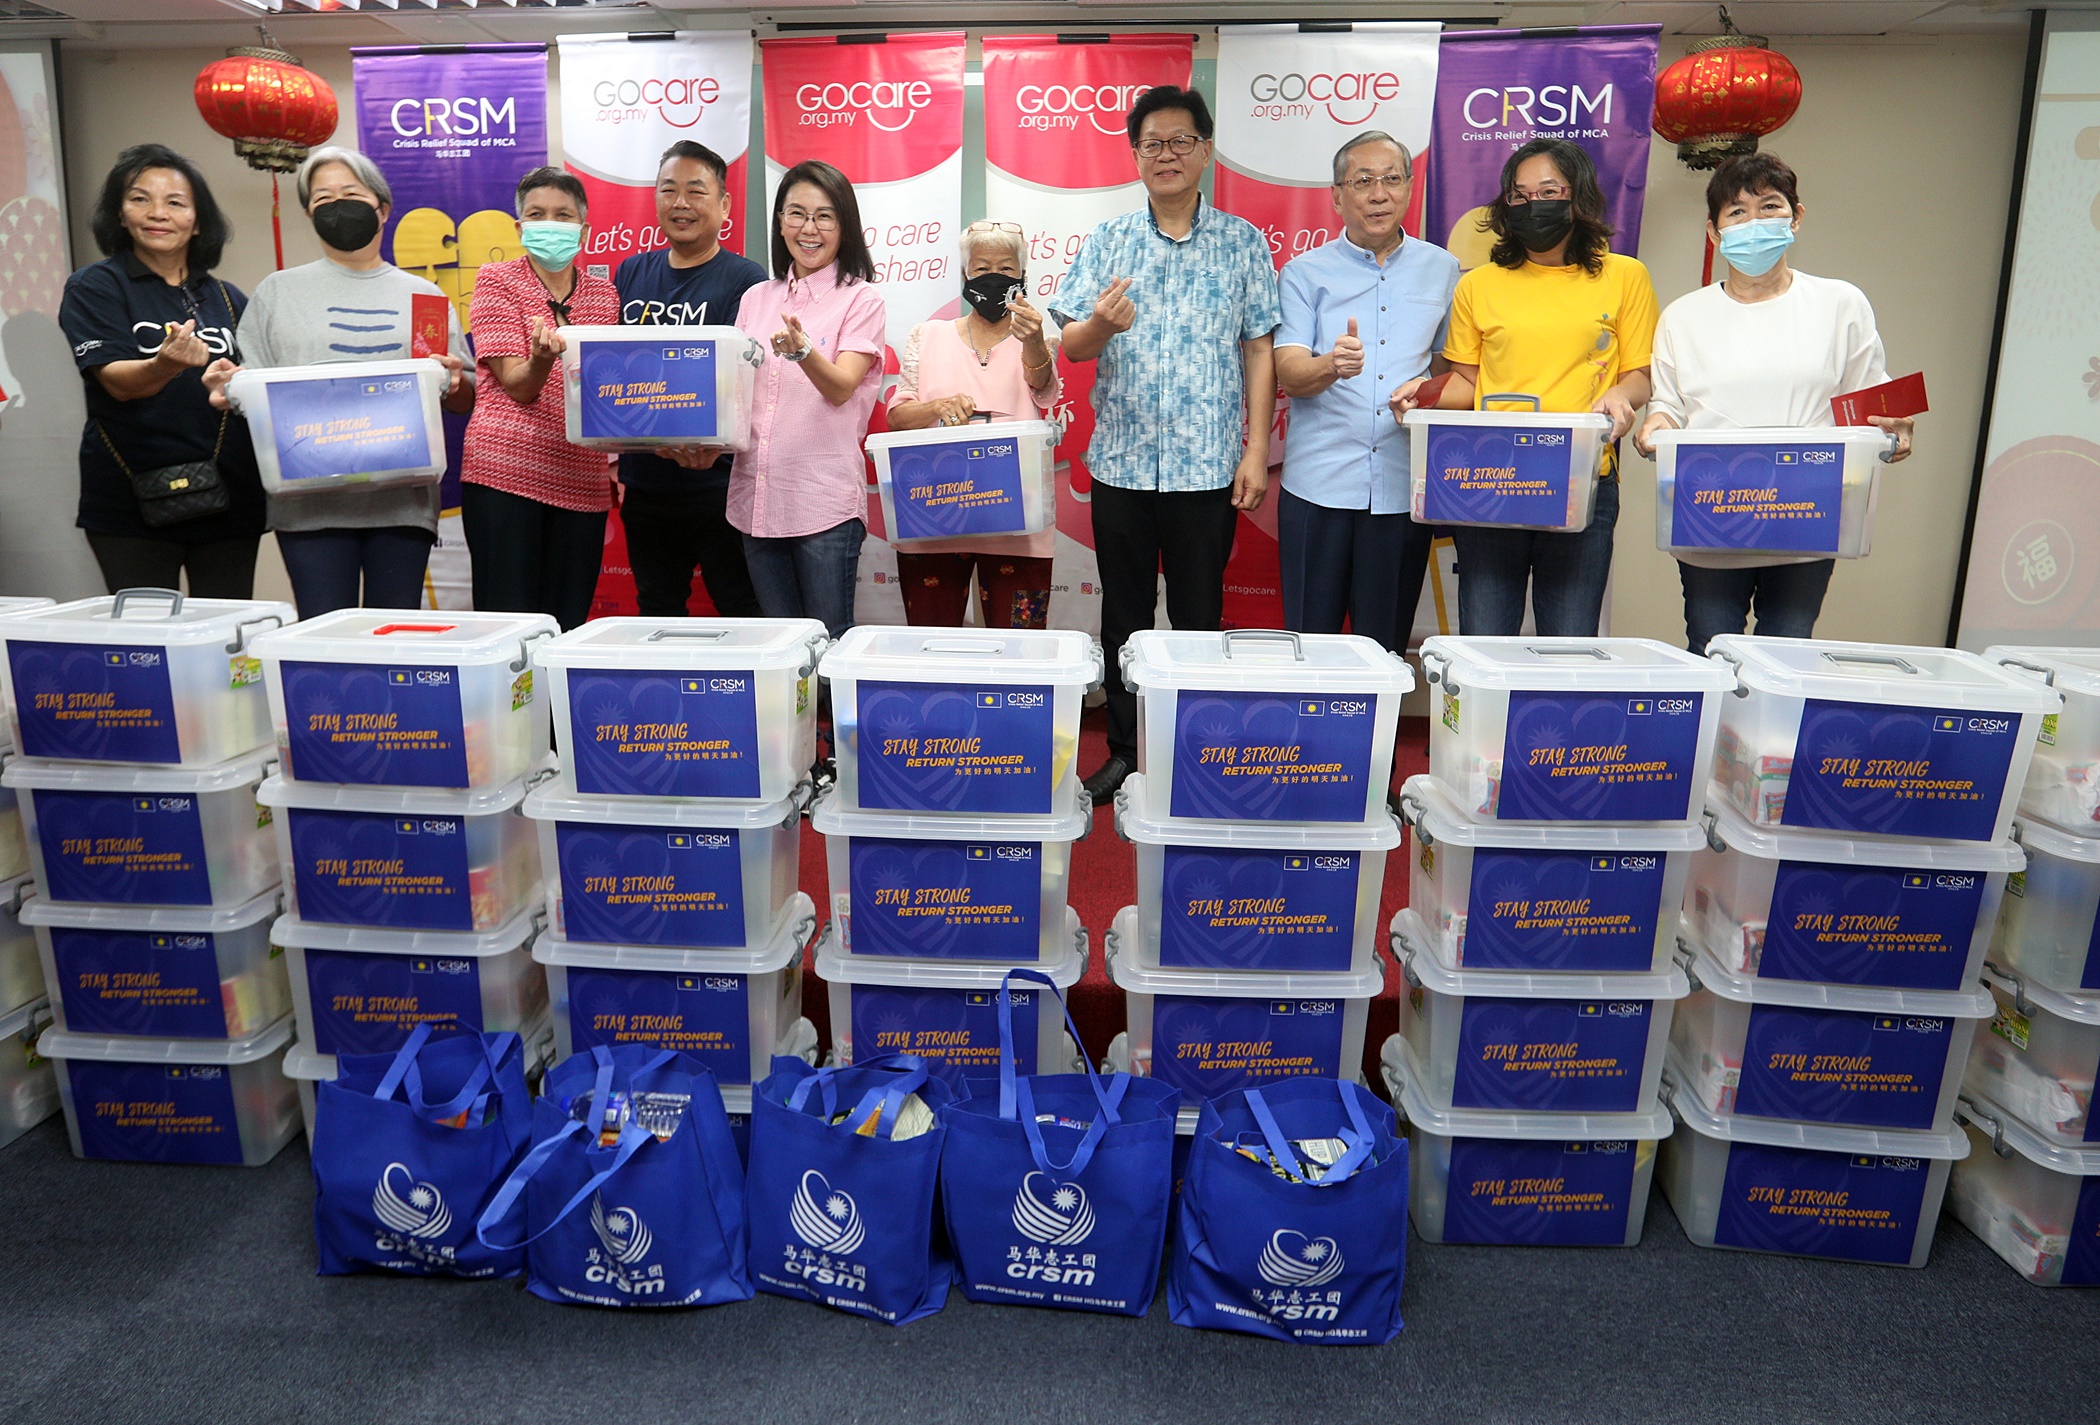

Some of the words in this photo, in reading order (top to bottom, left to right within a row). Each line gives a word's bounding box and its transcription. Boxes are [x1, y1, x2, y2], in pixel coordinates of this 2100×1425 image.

[1250, 103, 1314, 122] .org.my
[1463, 84, 1613, 129] CRSM
[391, 97, 516, 136] CRSM
[595, 108, 648, 125] .org.my
[798, 111, 857, 128] .org.my
[1018, 112, 1079, 131] .org.my
[392, 140, 419, 148] Crisis
[421, 138, 448, 147] Relief
[449, 138, 479, 148] Squad
[481, 138, 491, 146] of
[493, 138, 516, 147] MCA
[1462, 132, 1492, 141] Crisis
[1495, 130, 1527, 140] Relief
[1530, 130, 1564, 140] Squad
[1568, 130, 1579, 139] of
[1583, 129, 1609, 138] MCA
[584, 222, 634, 254] Let's
[886, 222, 942, 246] care
[872, 255, 948, 284] share!
[623, 299, 708, 326] CRSM
[683, 348, 708, 356] CRSM
[598, 384, 624, 398] STAY
[626, 381, 667, 396] STRONG
[614, 396, 650, 406] RETURN
[650, 393, 697, 403] STRONGER
[1537, 434, 1564, 443] CRSM
[987, 445, 1010, 455] CRSM
[1802, 452, 1834, 461] CRSM
[1443, 468, 1471, 482] STAY
[1473, 467, 1516, 480] STRONG
[909, 485, 933, 500] STAY
[936, 480, 974, 497] STRONG
[1460, 481, 1497, 490] RETURN
[1498, 480, 1547, 489] STRONGER
[926, 496, 959, 506] RETURN
[960, 489, 1003, 502] STRONGER
[1693, 490, 1725, 505] STAY
[1728, 488, 1778, 503] STRONG
[1712, 504, 1756, 514] RETURN
[1756, 502, 1815, 512] STRONGER
[2016, 534, 2058, 590] 福
[417, 670, 449, 681] CRSM
[710, 678, 744, 689] CRSM
[34, 693, 64, 710] STAY
[68, 692, 115, 709] STRONG
[1007, 693, 1042, 704] CRSM
[1330, 701, 1367, 712] CRSM
[1657, 699, 1692, 710] CRSM
[55, 710, 97, 720] RETURN
[98, 709, 152, 719] STRONGER
[309, 714, 341, 732] STAY
[346, 713, 398, 730] STRONG
[595, 724, 629, 742] STAY
[634, 722, 688, 741] STRONG
[1967, 718, 2007, 730] CRSM
[331, 732, 377, 743] RETURN
[378, 730, 438, 742] STRONGER
[618, 742, 666, 753] RETURN
[667, 740, 730, 752] STRONGER
[882, 739, 919, 757] STAY
[923, 737, 981, 755] STRONG
[906, 757, 956, 768] RETURN
[958, 755, 1024, 767] STRONGER
[1200, 747, 1238, 765] STAY
[1241, 745, 1301, 764] STRONG
[1529, 748, 1566, 766] STAY
[1569, 744, 1628, 764] STRONG
[1222, 765, 1274, 776] RETURN
[1275, 763, 1343, 775] STRONGER
[1550, 765, 1601, 777] RETURN
[1602, 761, 1668, 774] STRONGER
[1819, 758, 1862, 777] STAY
[1864, 759, 1931, 778] STRONG
[1842, 778, 1899, 788] RETURN
[1899, 779, 1974, 790] STRONGER
[695, 834, 729, 844] CRSM
[996, 845, 1031, 856] CRSM
[316, 859, 348, 876] STAY
[352, 859, 404, 875] STRONG
[1314, 855, 1350, 866] CRSM
[1620, 856, 1654, 867] CRSM
[337, 877, 383, 886] RETURN
[384, 876, 444, 886] STRONGER
[584, 877, 618, 894] STAY
[622, 875, 675, 892] STRONG
[1935, 874, 1973, 886] CRSM
[606, 894, 653, 904] RETURN
[655, 892, 716, 903] STRONGER
[875, 889, 910, 906] STAY
[914, 887, 971, 905] STRONG
[897, 906, 946, 917] RETURN
[948, 905, 1013, 916] STRONGER
[1187, 899, 1224, 917] STAY
[1228, 897, 1286, 915] STRONG
[1493, 901, 1530, 918] STAY
[1533, 898, 1591, 917] STRONG
[1209, 917, 1260, 927] RETURN
[1261, 914, 1328, 926] STRONGER
[1514, 918, 1565, 929] RETURN
[1566, 915, 1631, 927] STRONGER
[1794, 914, 1835, 932] STAY
[1837, 915, 1901, 931] STRONG
[1816, 933, 1870, 942] RETURN
[1871, 933, 1942, 943] STRONGER
[1905, 1017, 1943, 1029] CRSM
[1769, 1054, 1808, 1071] STAY
[1810, 1055, 1872, 1072] STRONG
[1790, 1072, 1843, 1082] RETURN
[1844, 1073, 1914, 1083] STRONGER
[784, 1244, 866, 1279] 马华志工团
[1007, 1246, 1096, 1268] 马华志工团
[585, 1265, 665, 1295] crsm
[784, 1260, 866, 1292] crsm
[1007, 1262, 1095, 1286] crsm
[975, 1284, 1044, 1300] www.crsm.org.my
[1252, 1288, 1341, 1305] 马华志工团
